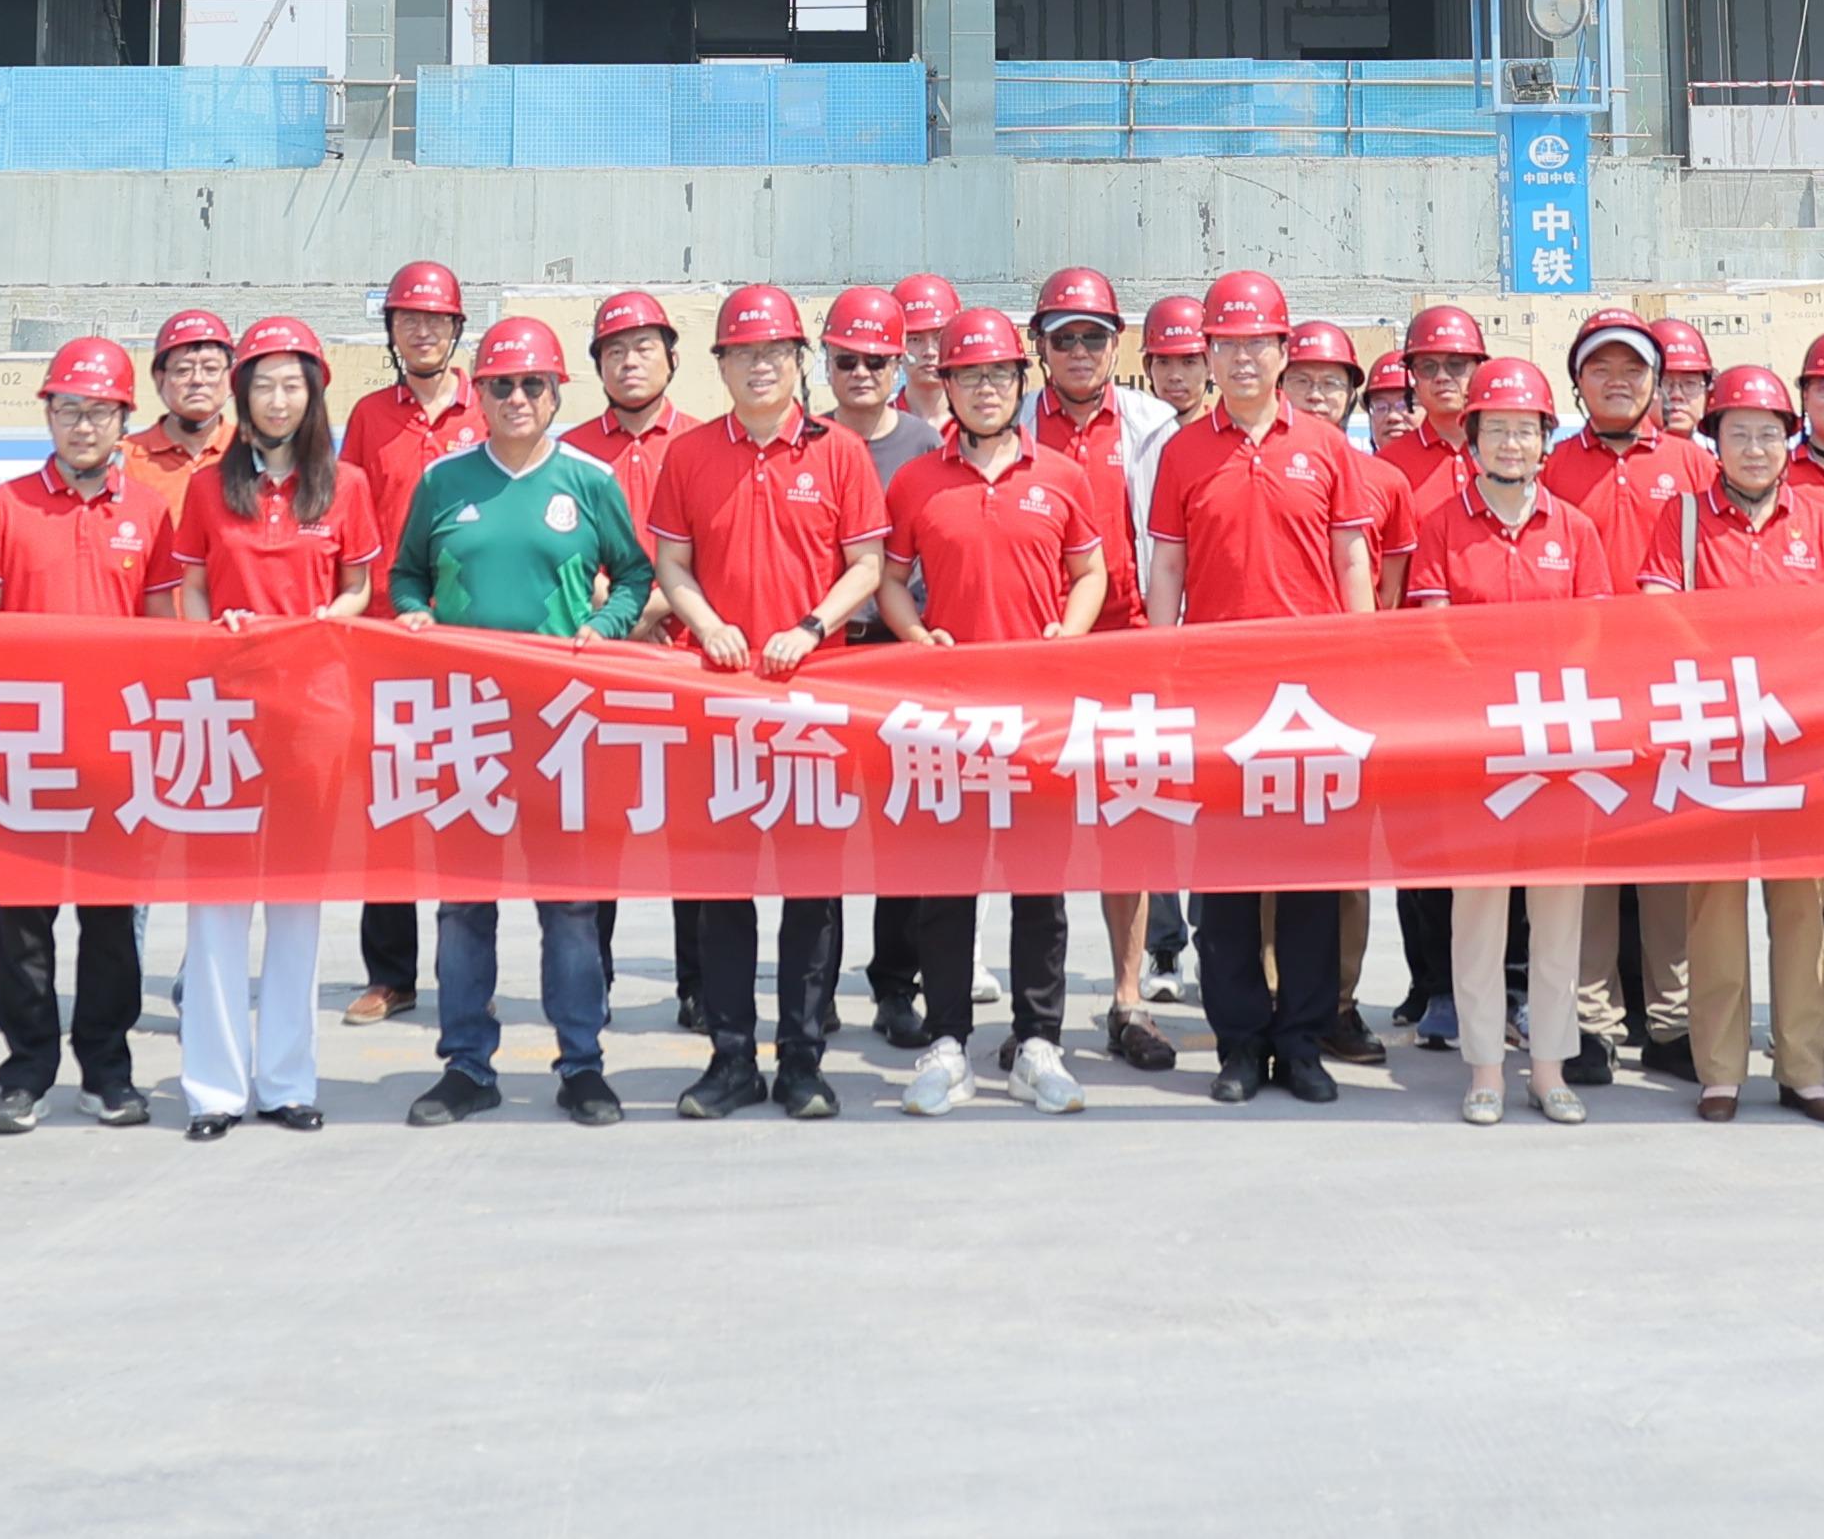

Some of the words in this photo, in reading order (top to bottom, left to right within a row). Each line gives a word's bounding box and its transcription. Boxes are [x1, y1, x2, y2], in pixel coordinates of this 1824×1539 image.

[1523, 172, 1576, 185] 中国中铁
[1532, 203, 1574, 286] 中铁
[367, 672, 1378, 836] 践行疏解使命
